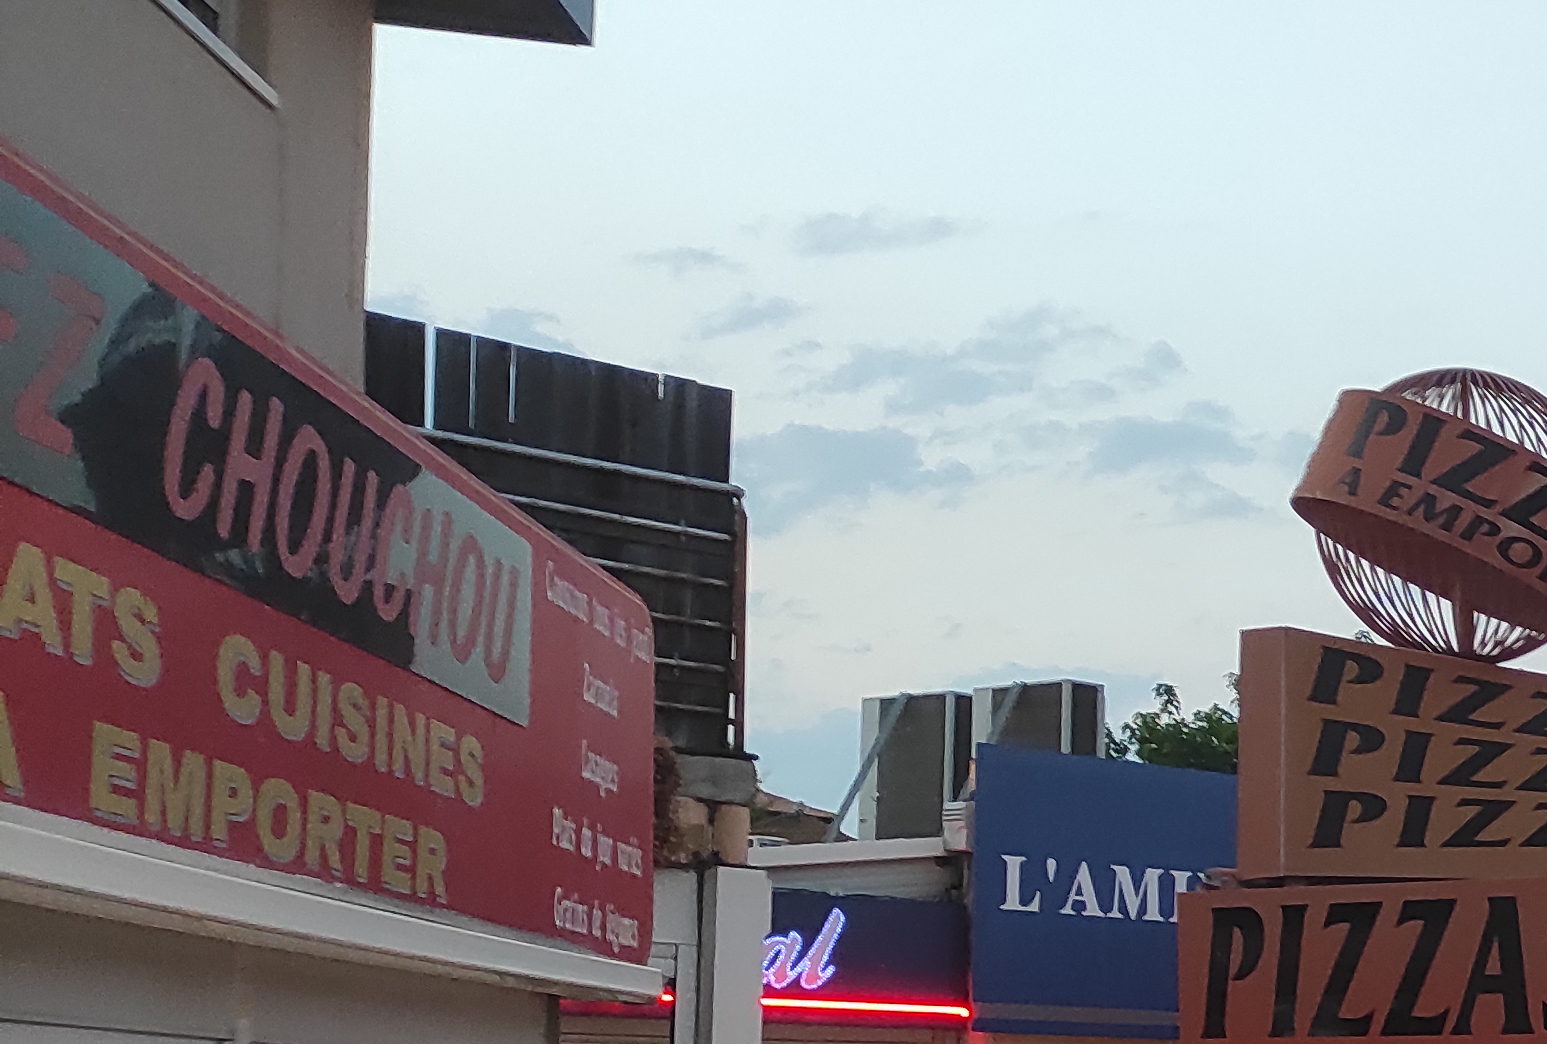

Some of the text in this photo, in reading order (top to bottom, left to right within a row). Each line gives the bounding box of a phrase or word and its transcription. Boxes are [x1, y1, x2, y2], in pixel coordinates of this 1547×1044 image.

[0, 233, 107, 455] Z
[163, 356, 523, 684] CHOUCHOU
[89, 719, 448, 903] EMPORTER
[216, 634, 484, 807] CUISINES
